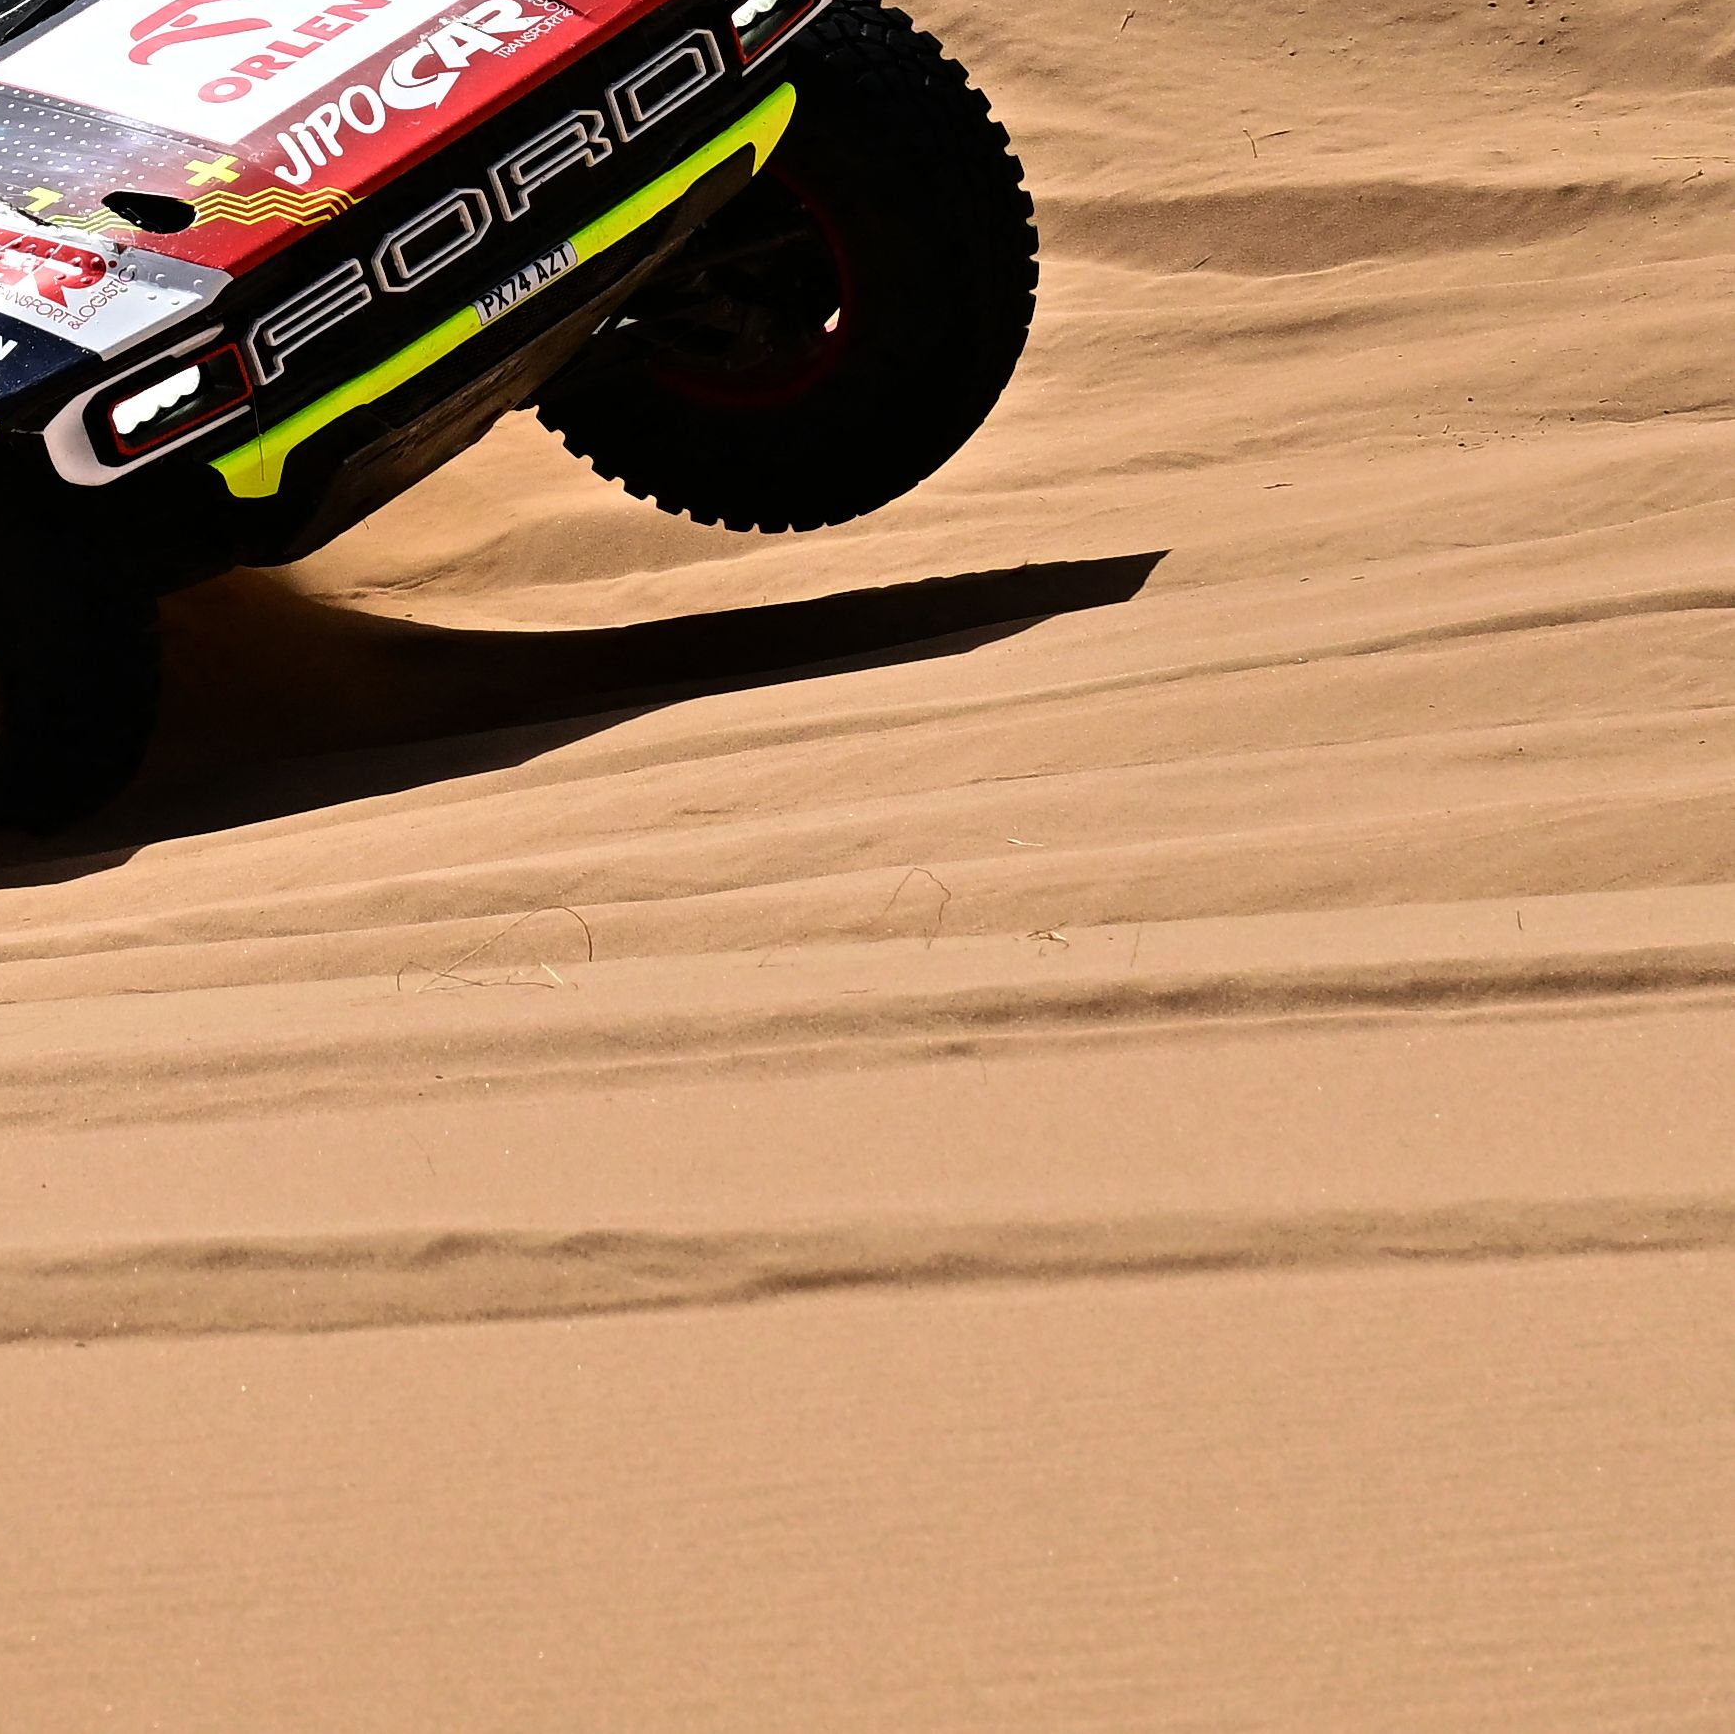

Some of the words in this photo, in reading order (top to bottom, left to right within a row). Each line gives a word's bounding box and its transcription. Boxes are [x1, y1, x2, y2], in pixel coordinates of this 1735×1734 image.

[493, 15, 565, 59] TRANSPORT
[247, 29, 726, 387] FORD
[480, 271, 531, 319] PX74
[533, 244, 569, 284] AZT
